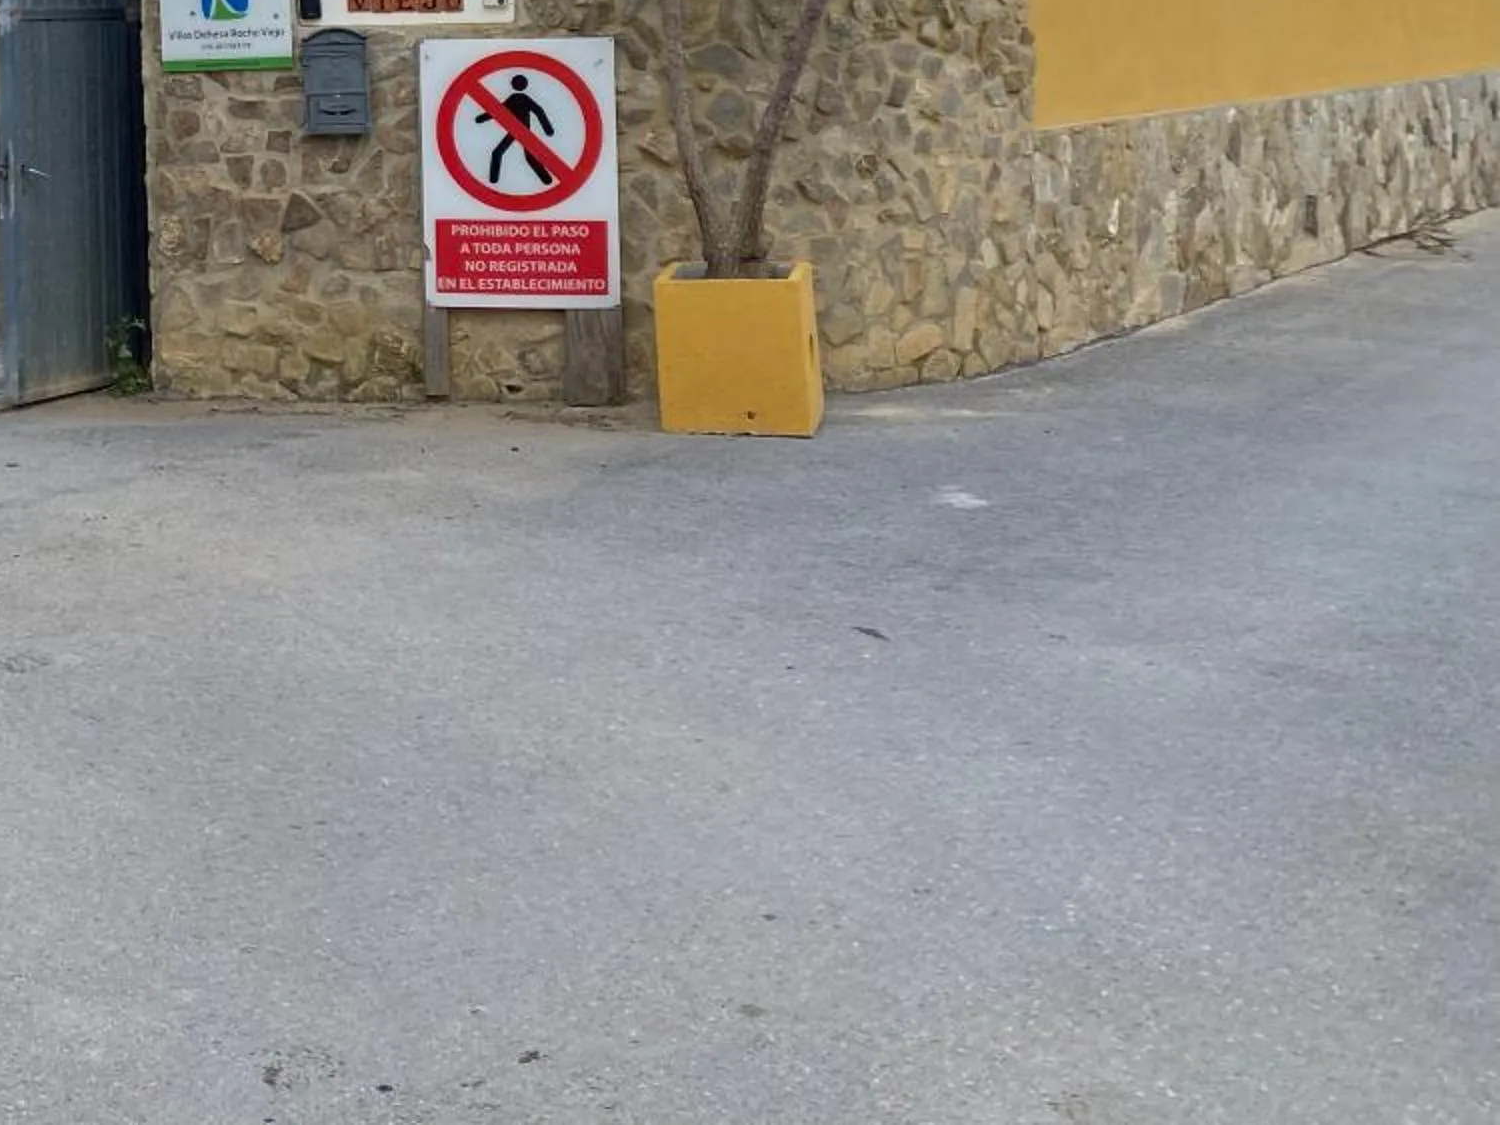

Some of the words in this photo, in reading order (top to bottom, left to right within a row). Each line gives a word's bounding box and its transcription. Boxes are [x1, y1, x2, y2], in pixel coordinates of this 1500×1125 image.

[451, 225, 529, 237] PROHIBIDO
[533, 225, 548, 237] EL
[552, 225, 589, 238] PASO
[460, 243, 470, 254] A
[474, 243, 512, 254] TODA
[515, 243, 581, 255] PERSONA
[465, 261, 486, 272] NO
[489, 261, 578, 273] REGISTRADA
[438, 278, 457, 290] EN
[459, 278, 475, 290] EL
[479, 278, 605, 290] ESTABLECIMIENTO
